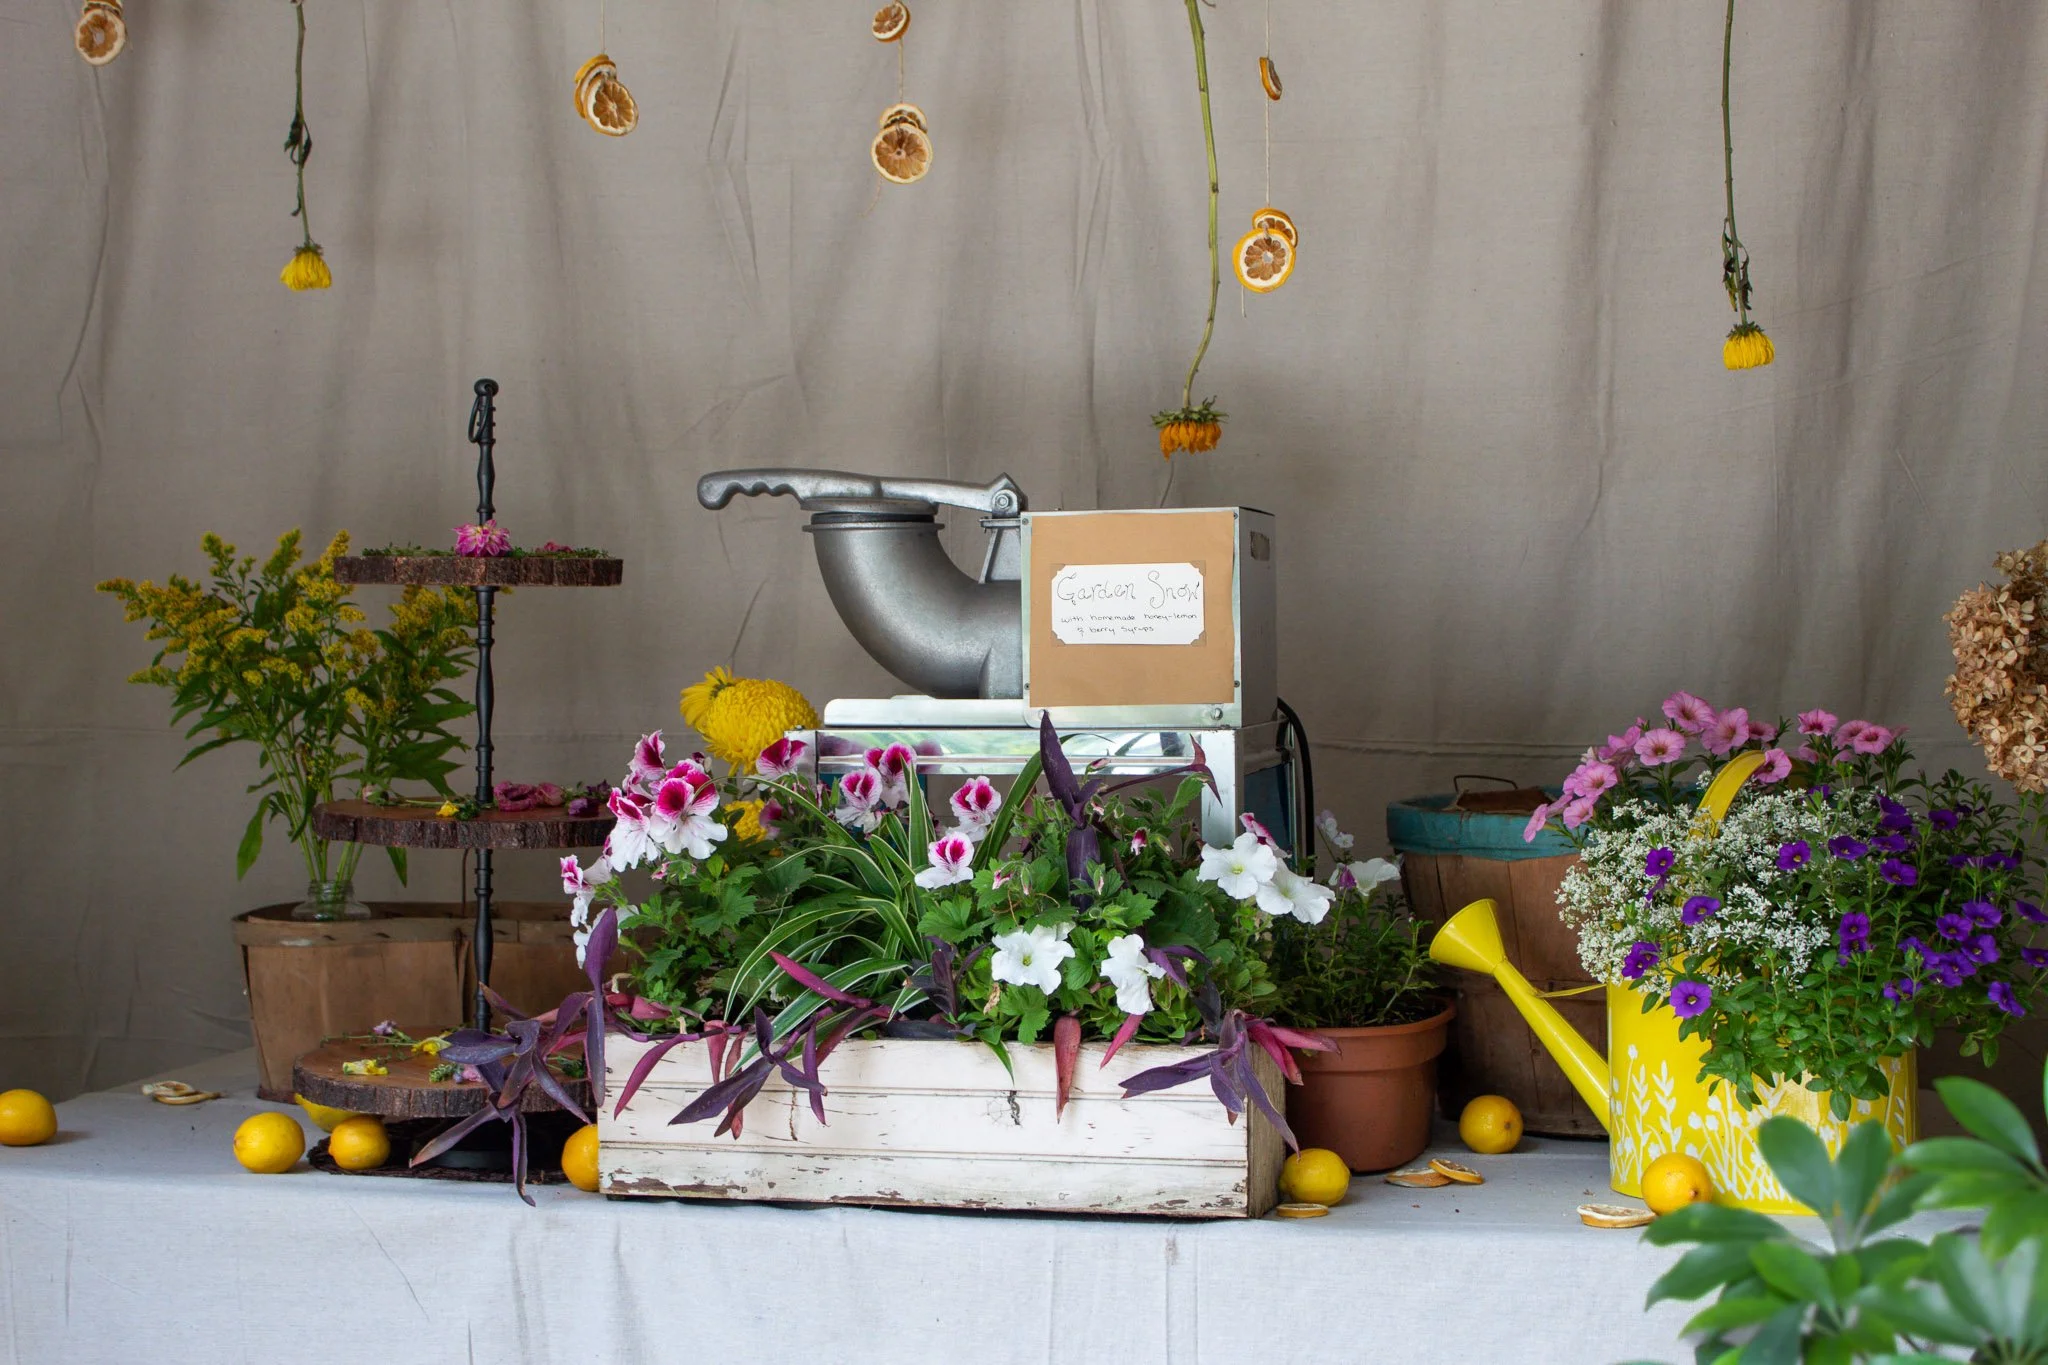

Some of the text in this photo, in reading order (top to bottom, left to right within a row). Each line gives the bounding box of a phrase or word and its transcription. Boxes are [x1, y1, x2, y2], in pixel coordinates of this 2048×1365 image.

[1057, 570, 1200, 609] Garden Snow
[1061, 614, 1084, 623] with
[1089, 626, 1115, 635] berry
